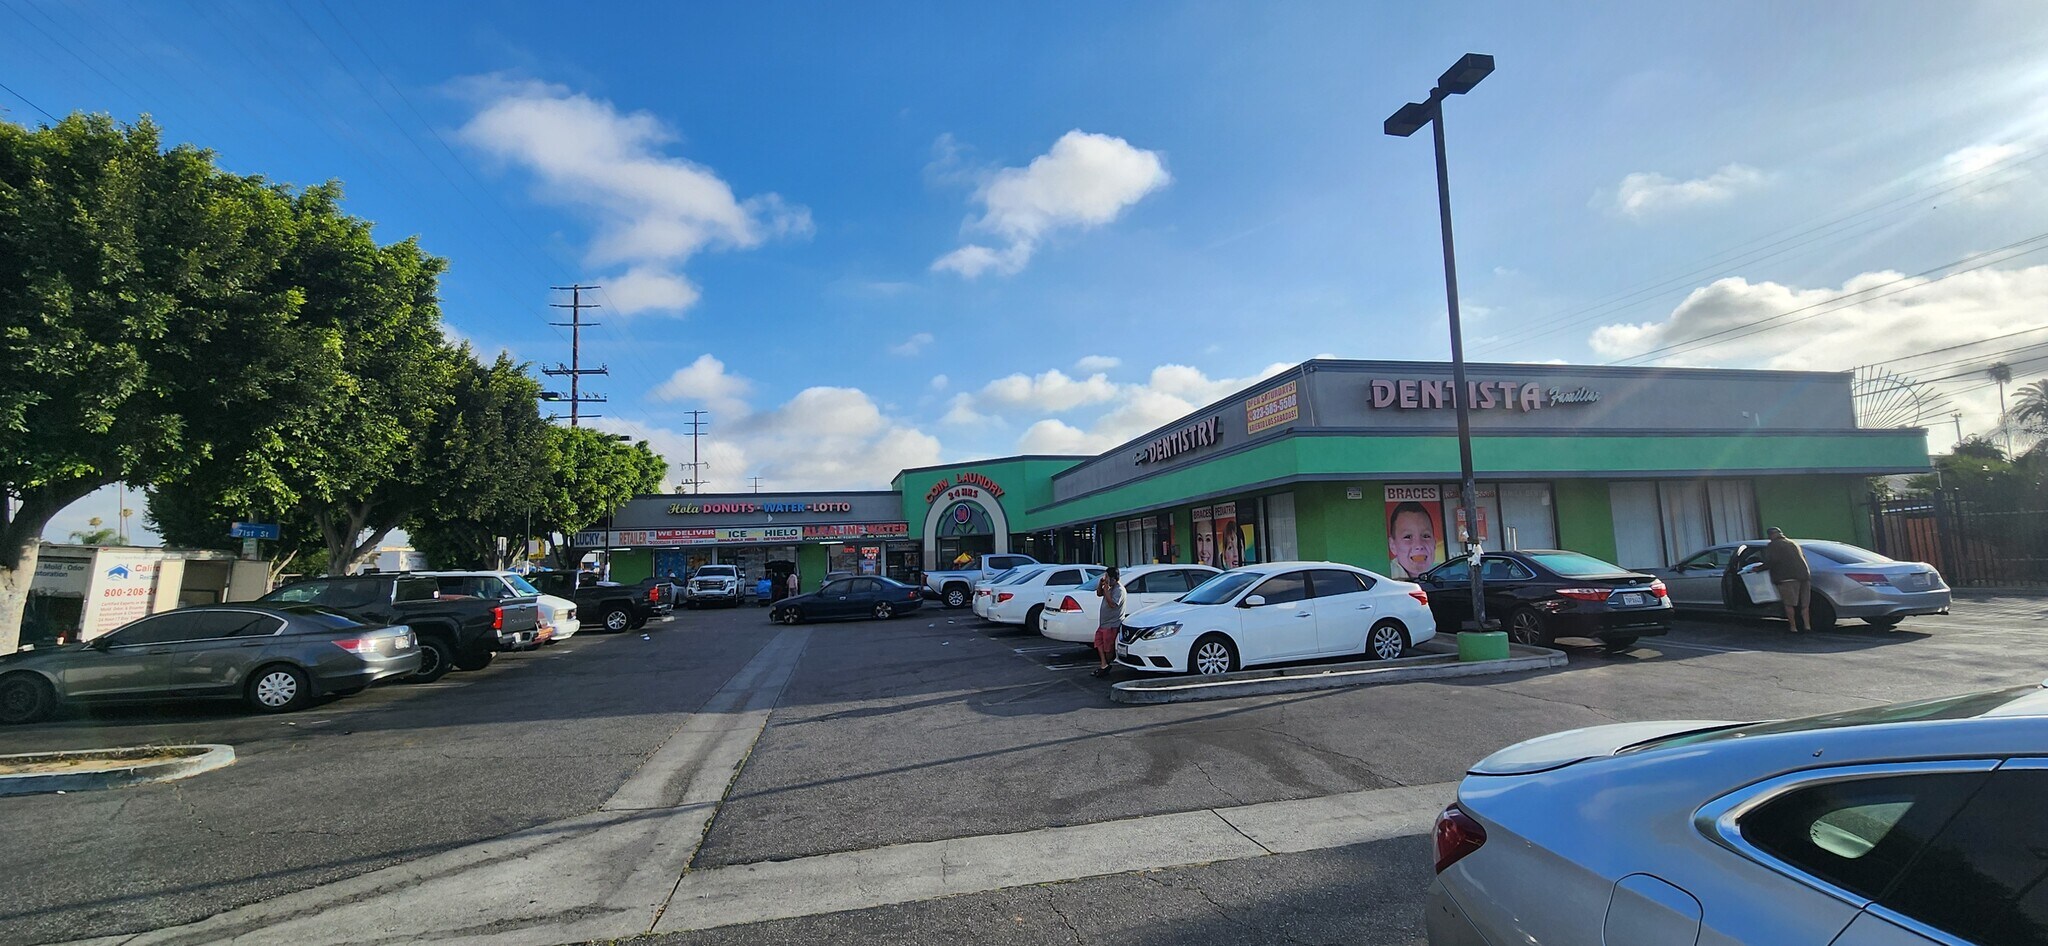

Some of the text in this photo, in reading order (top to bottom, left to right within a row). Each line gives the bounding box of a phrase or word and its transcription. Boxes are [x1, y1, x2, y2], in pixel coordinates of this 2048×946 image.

[1371, 379, 1542, 413] DENTISTA
[1148, 416, 1217, 463] DENTISTRY
[925, 472, 1006, 504] COIN LAUNDRY
[947, 487, 979, 501] 24 HRS
[1387, 487, 1437, 500] BRACES
[667, 501, 851, 515] Hola DONUTS WATER LOTTO
[1193, 508, 1212, 520] BRACES
[238, 529, 269, 538] 71st St
[674, 529, 715, 537] DELIVER
[728, 530, 748, 538] ICE
[764, 528, 798, 537] HIELO
[803, 523, 908, 537] ALKALINE WATER
[575, 532, 600, 546] LUCKY
[618, 531, 647, 546] RETAILER
